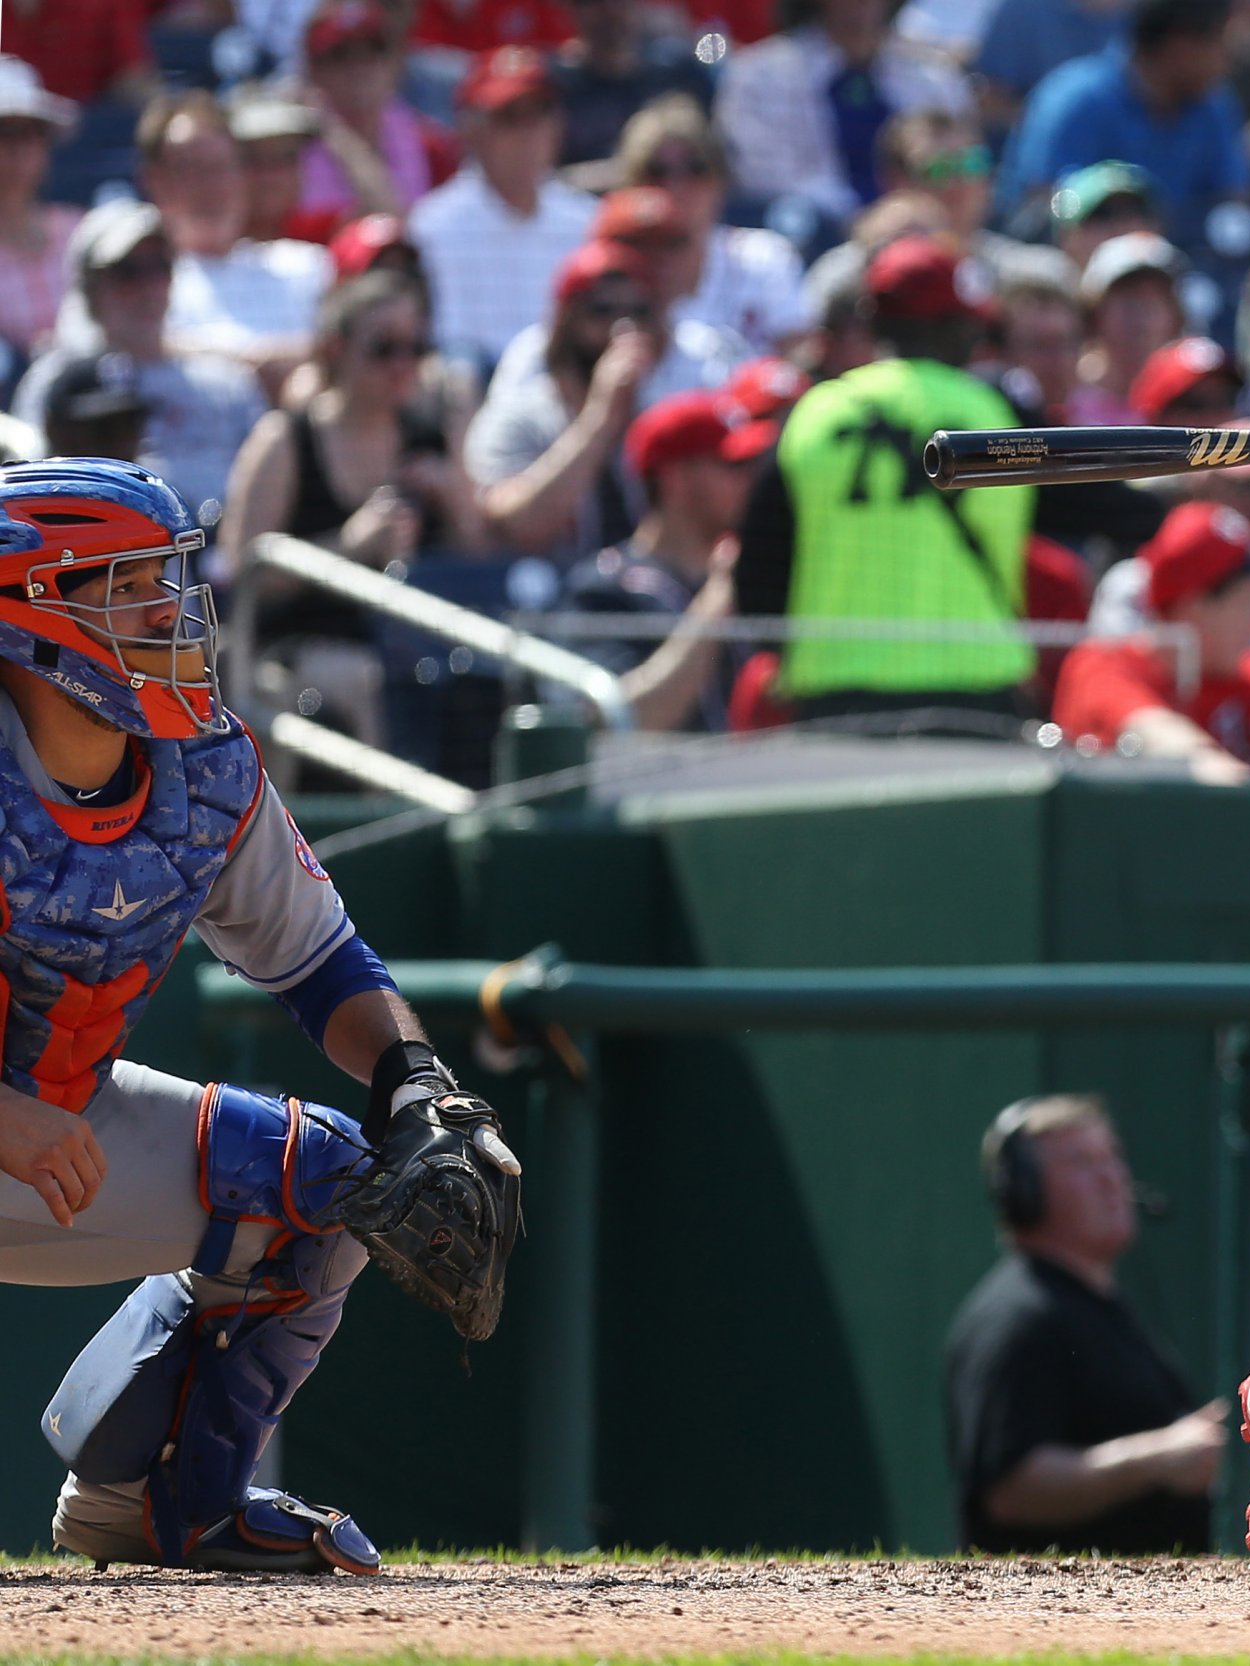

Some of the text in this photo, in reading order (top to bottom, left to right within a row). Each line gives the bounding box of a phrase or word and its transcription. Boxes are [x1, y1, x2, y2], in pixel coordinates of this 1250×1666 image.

[987, 443, 1048, 456] Anthony Rendon
[45, 671, 103, 707] ALL-STAR
[91, 812, 135, 832] RIVERA
